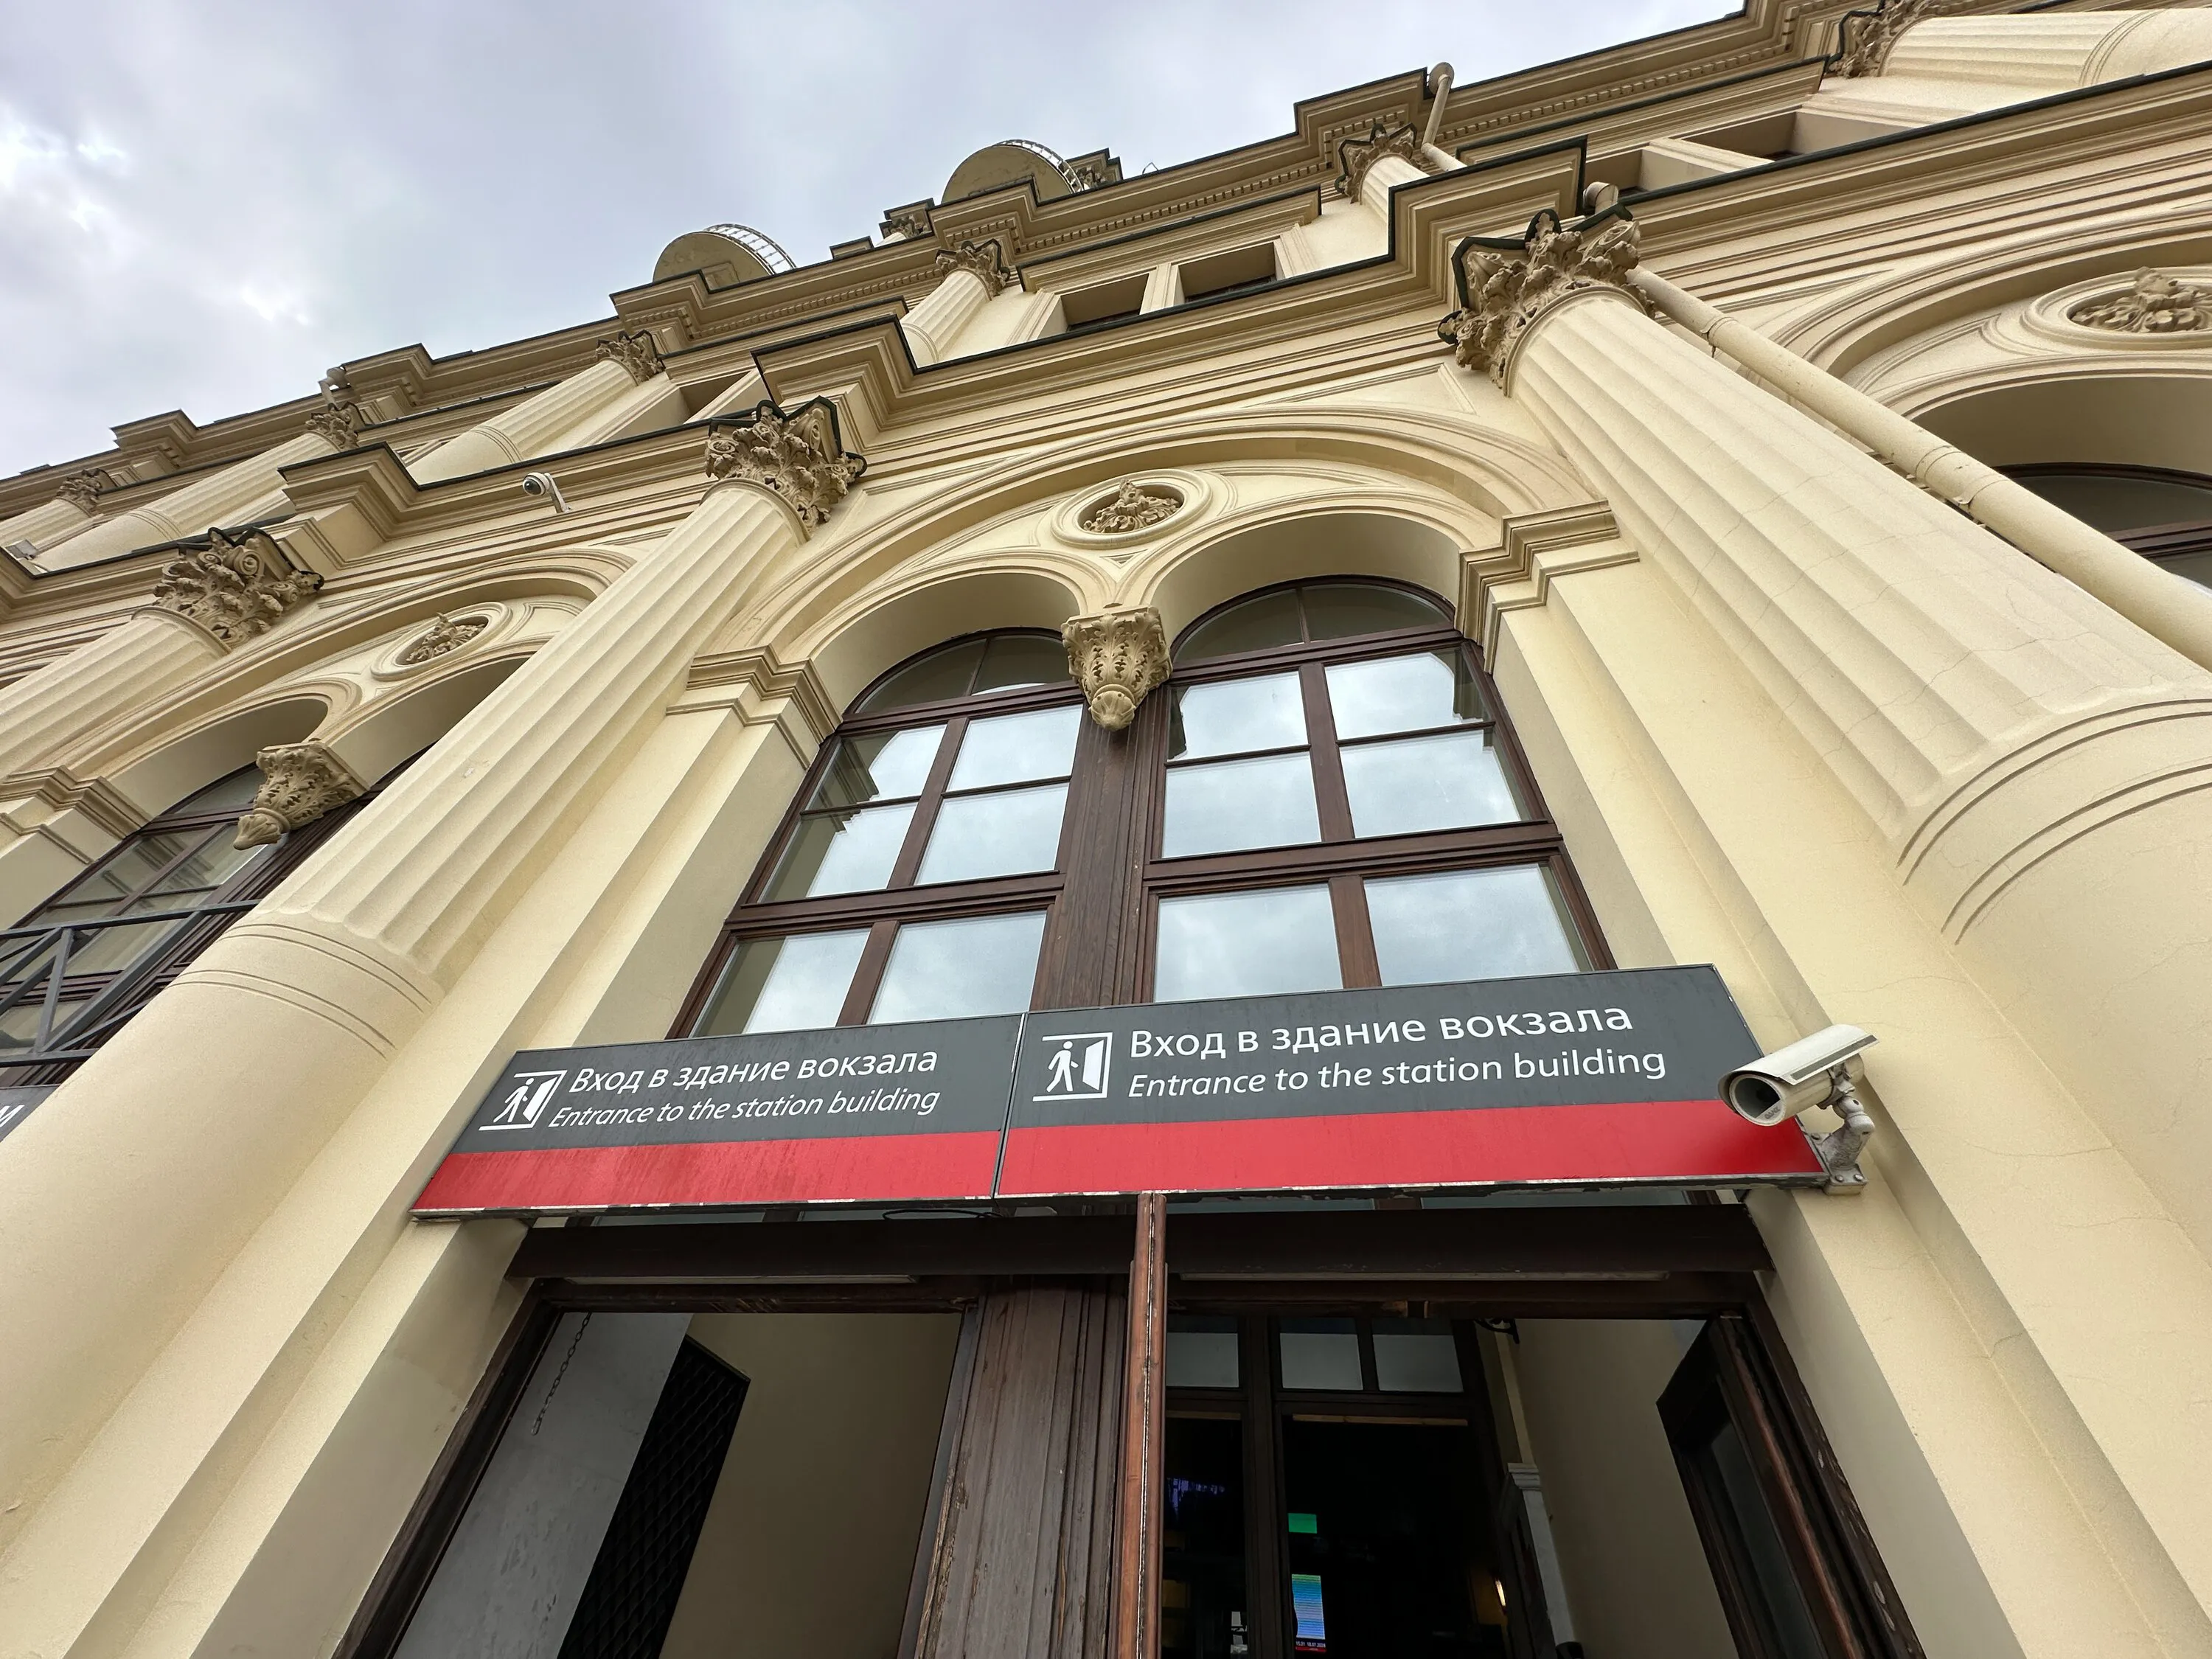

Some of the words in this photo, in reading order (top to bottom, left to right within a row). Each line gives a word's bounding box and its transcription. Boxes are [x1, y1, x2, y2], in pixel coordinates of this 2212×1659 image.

[1130, 1030, 1226, 1060] Вход
[1238, 1031, 1259, 1052] в
[1272, 1020, 1426, 1054] здание
[1439, 1008, 1633, 1040] вокзала
[568, 1068, 645, 1095] Вход
[647, 1068, 669, 1088] в
[672, 1060, 790, 1091] здание
[796, 1051, 938, 1079] вокзала
[1128, 1074, 1266, 1097] Entrance
[1274, 1068, 1309, 1091] to
[1318, 1062, 1372, 1088] the
[1381, 1057, 1502, 1085] station
[1514, 1048, 1666, 1079] building
[548, 1107, 655, 1127] Entrance
[656, 1102, 684, 1122] to
[687, 1097, 731, 1121] the
[731, 1093, 824, 1119] station
[827, 1087, 941, 1116] building
